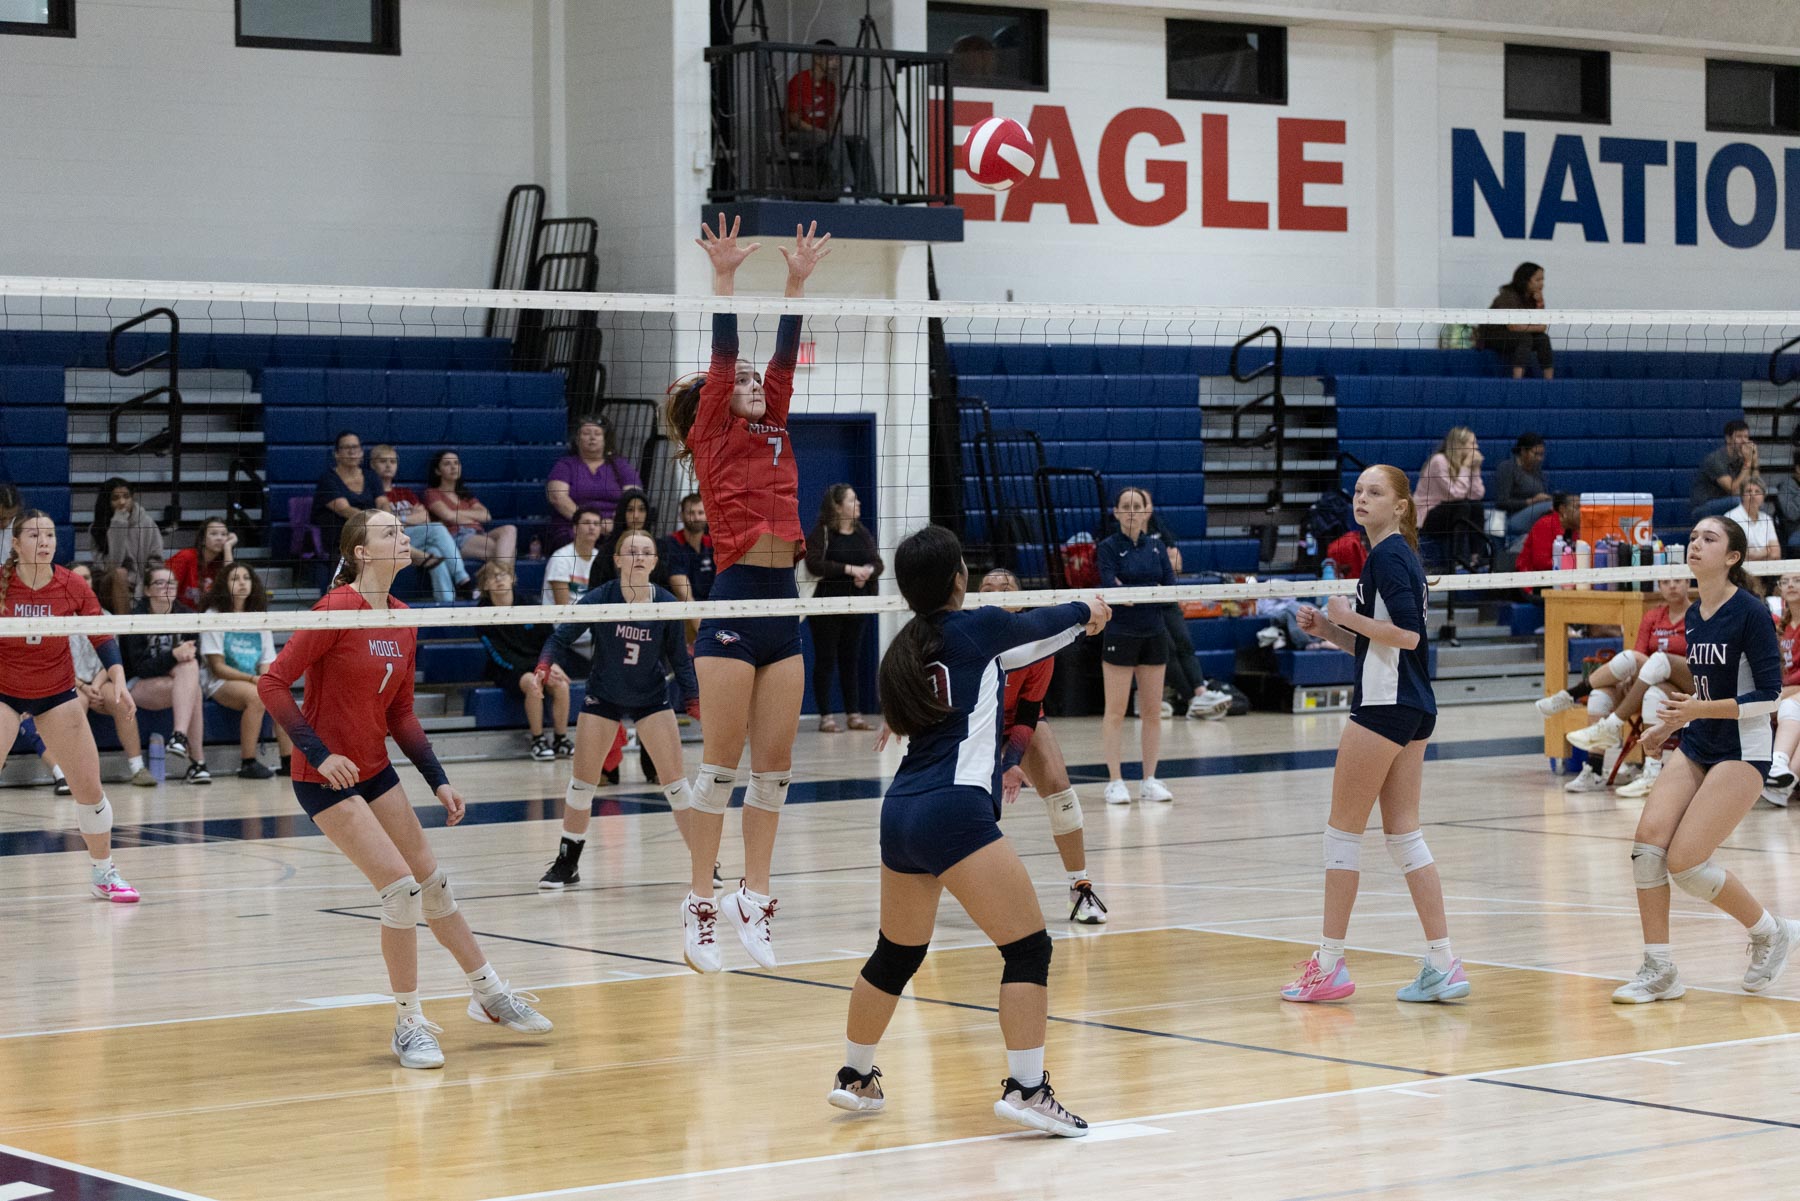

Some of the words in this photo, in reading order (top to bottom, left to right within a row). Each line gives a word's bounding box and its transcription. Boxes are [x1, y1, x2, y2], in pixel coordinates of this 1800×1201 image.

[928, 98, 1348, 232] EAGLE
[1451, 127, 1800, 251] NATIO
[767, 436, 782, 466] 7
[14, 603, 55, 617] MODEL
[615, 624, 653, 642] MODEL
[368, 639, 404, 658] MODEL
[623, 641, 641, 666] 3
[1686, 643, 1728, 665] ATIN
